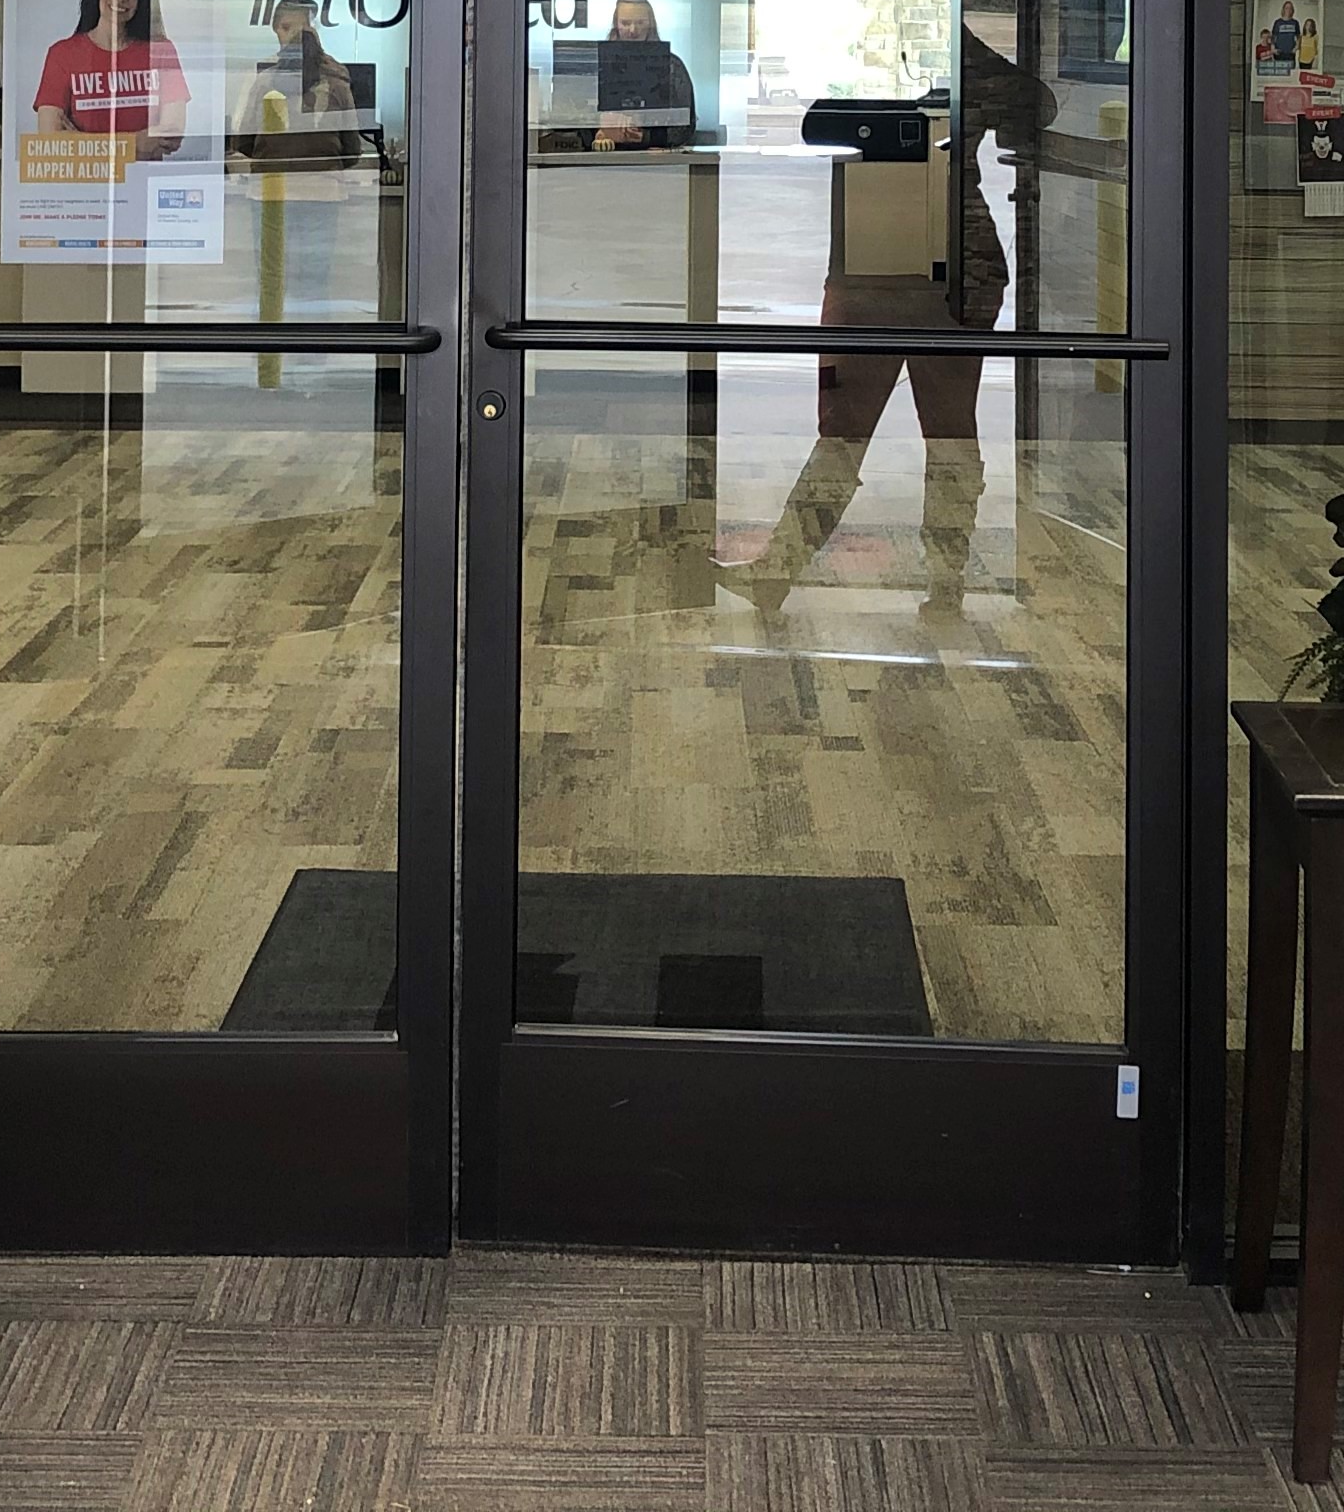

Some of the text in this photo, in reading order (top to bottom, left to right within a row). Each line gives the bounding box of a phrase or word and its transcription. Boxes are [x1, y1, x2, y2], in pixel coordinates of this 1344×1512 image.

[71, 69, 160, 95] LIVE UNITED
[27, 140, 129, 158] CHANGE DOESN'T
[27, 162, 74, 179] HAPPEN
[168, 199, 184, 208] Way
